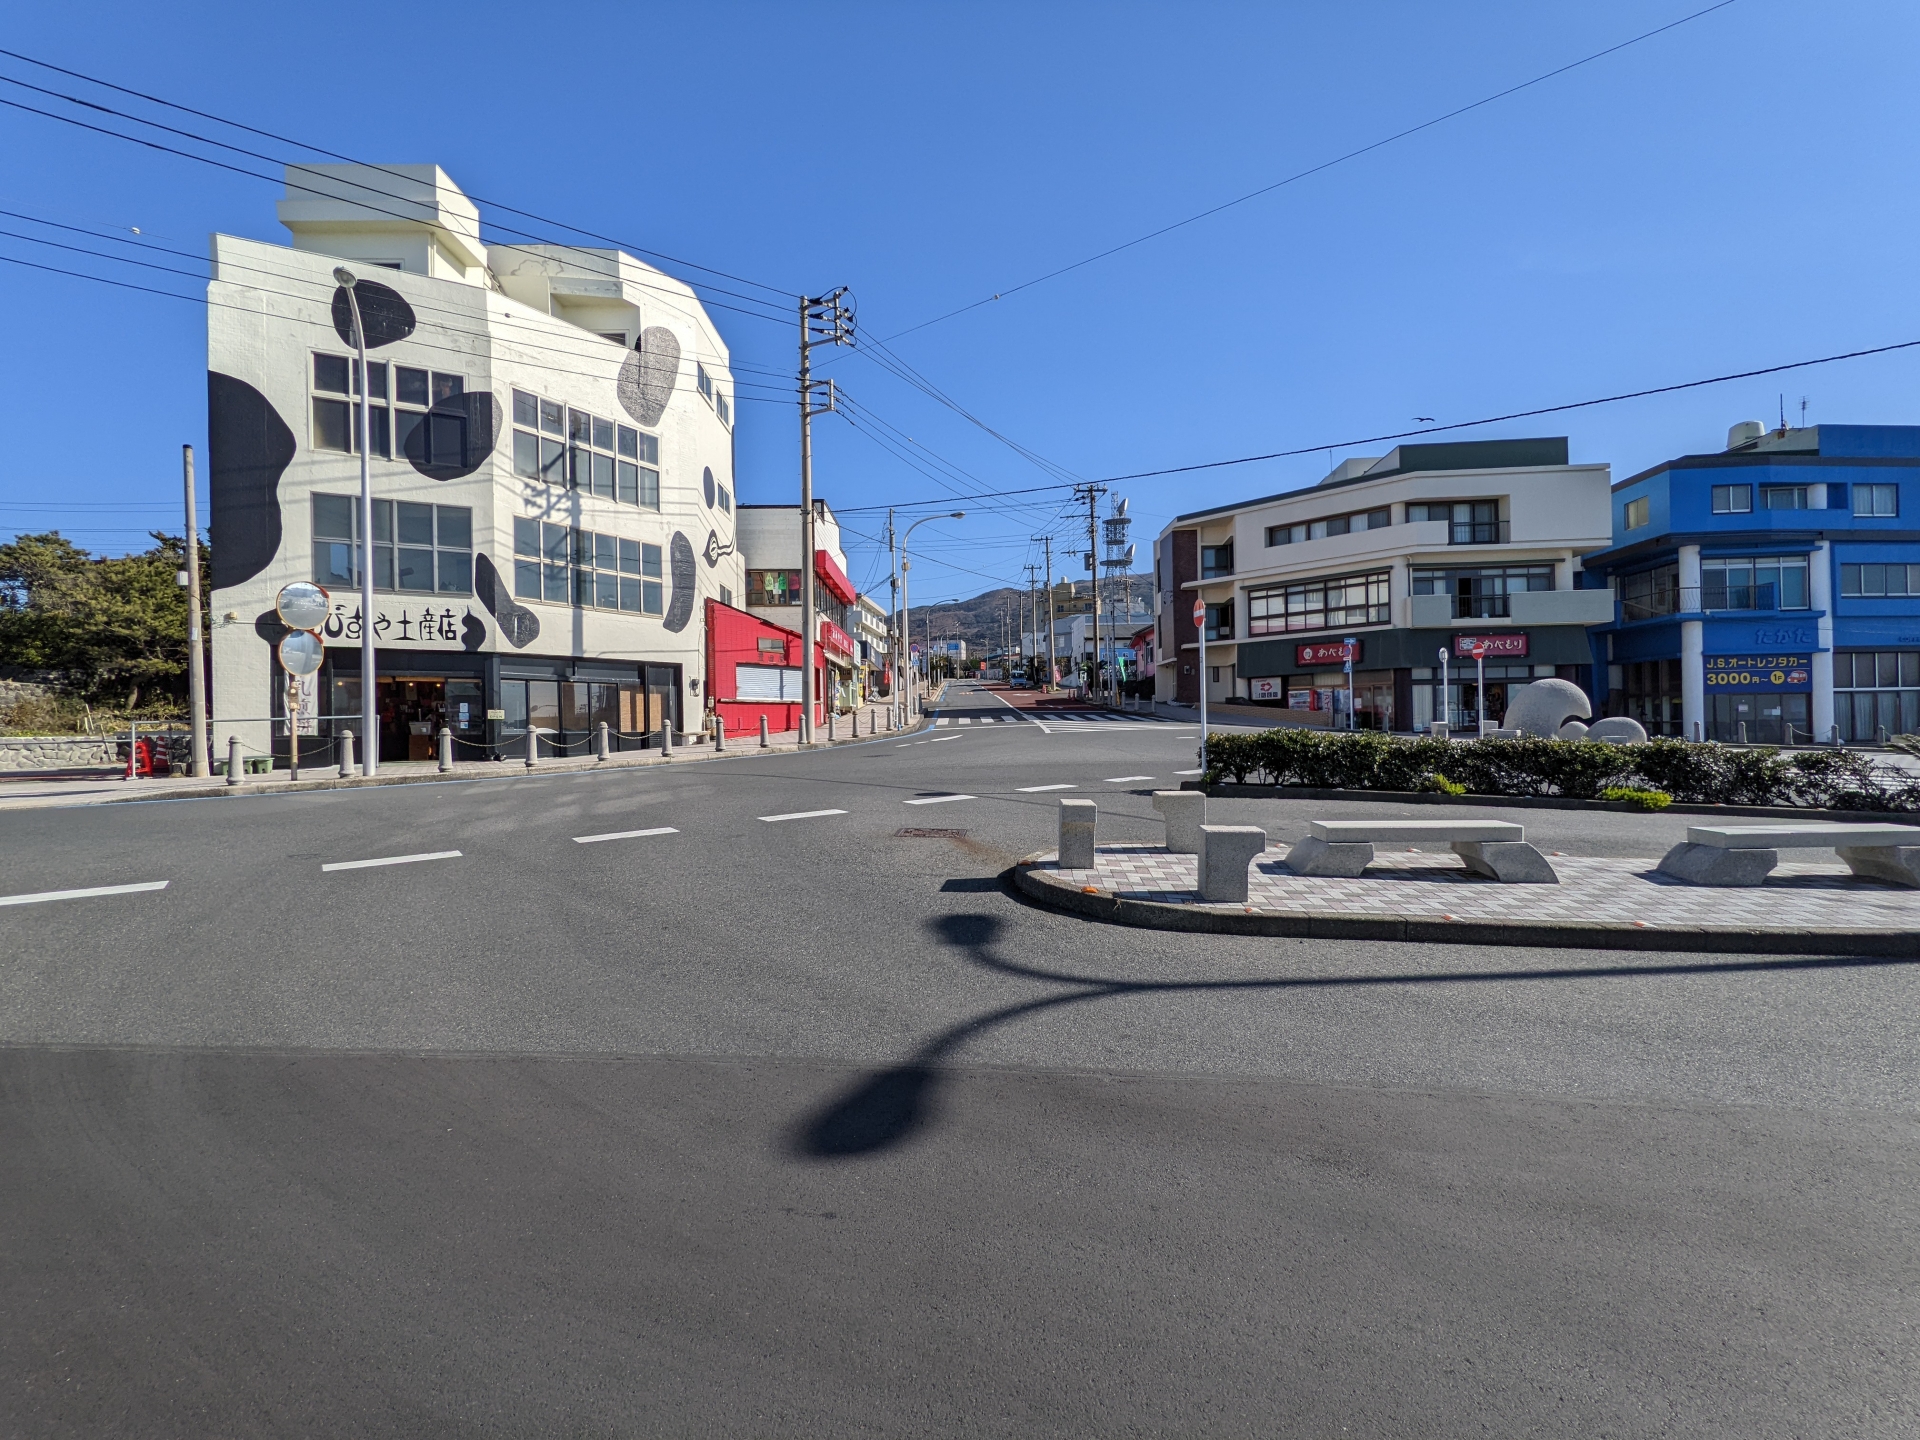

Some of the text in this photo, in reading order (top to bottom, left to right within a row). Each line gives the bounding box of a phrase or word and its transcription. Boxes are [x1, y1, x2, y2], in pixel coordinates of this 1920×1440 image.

[315, 604, 457, 641] びすや土産店
[1755, 628, 1812, 645] たかた
[1482, 639, 1522, 650] あべもり
[1317, 646, 1344, 658] あべも
